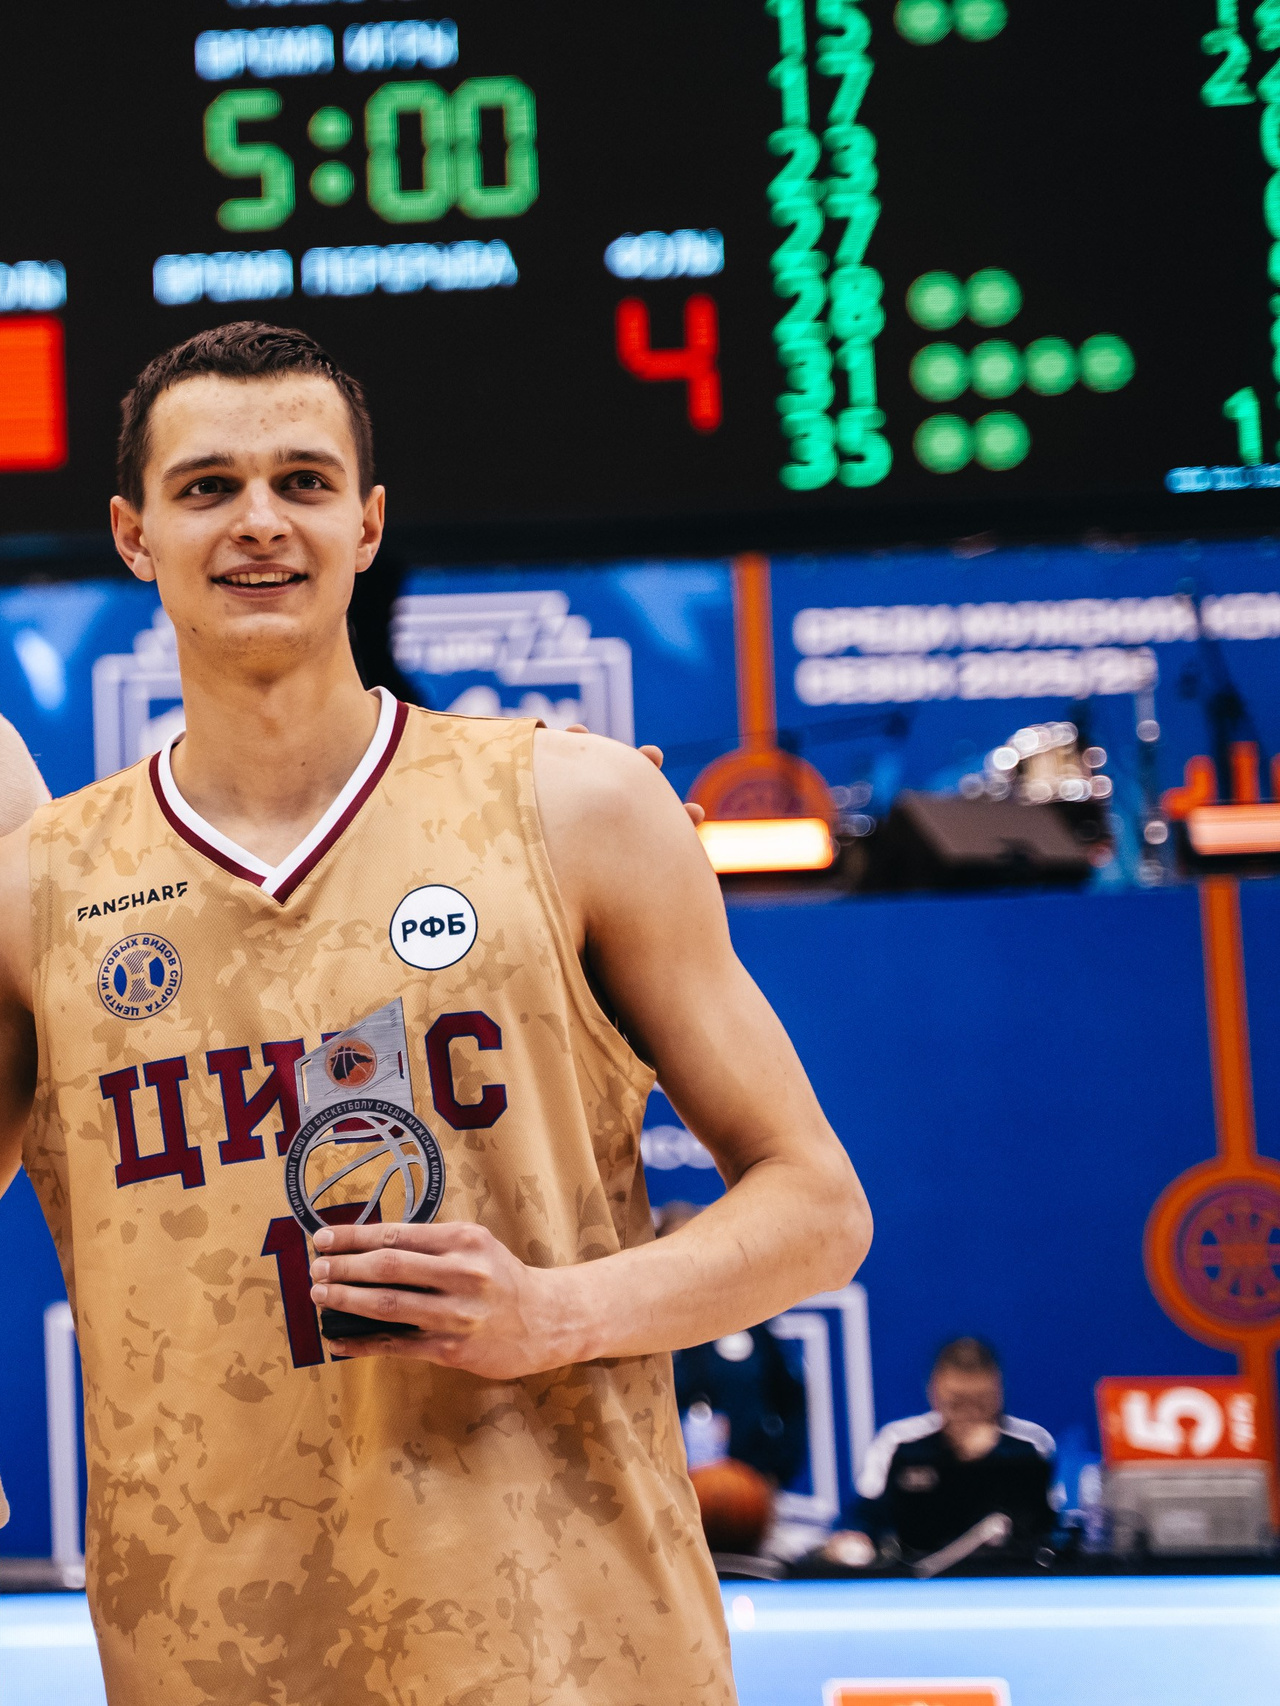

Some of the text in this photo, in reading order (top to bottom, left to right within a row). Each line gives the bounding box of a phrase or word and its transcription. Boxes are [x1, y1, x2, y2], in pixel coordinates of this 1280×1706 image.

[767, 52, 874, 128] 17
[203, 74, 540, 233] 5:00
[766, 124, 878, 202] 23
[770, 194, 881, 268] 27
[616, 293, 721, 433] 4
[401, 912, 466, 943] РФБ
[101, 937, 179, 1016] ЦЕНТР ИГРОВЫХ ВИДОВ СПОРТА
[99, 1010, 507, 1189] ЦИС
[288, 1101, 440, 1218] ЧЕМПИОНАТ ЦФО ПО БАСКЕТБОЛУ СРЕДИ МУЖСКИХ КОМАНД
[1121, 1386, 1225, 1457] 5
